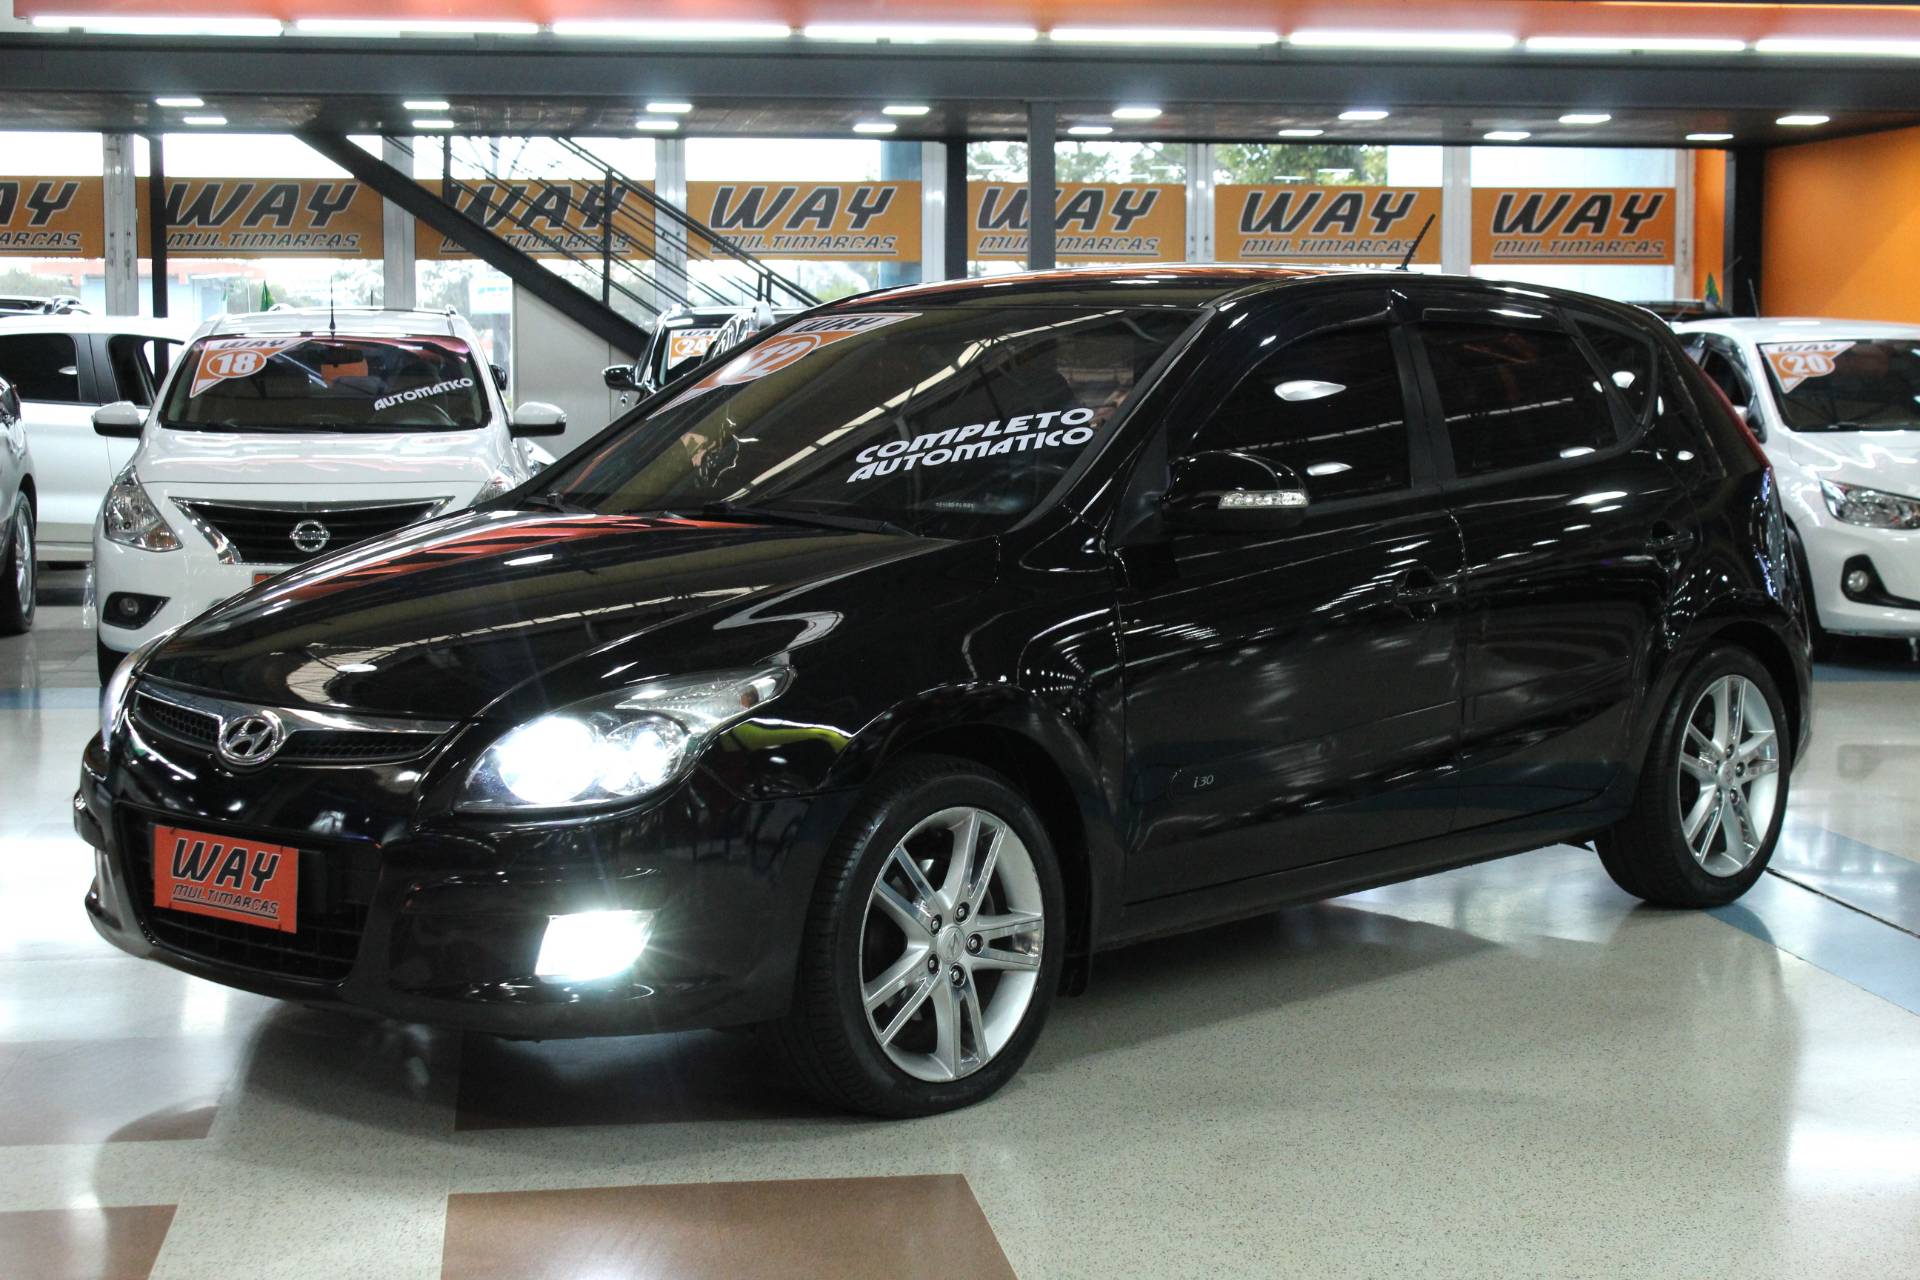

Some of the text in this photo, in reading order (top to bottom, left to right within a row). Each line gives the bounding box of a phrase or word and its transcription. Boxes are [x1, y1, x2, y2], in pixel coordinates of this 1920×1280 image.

[165, 182, 359, 228] WAY
[450, 184, 629, 230] WAY
[709, 186, 897, 230] WAY
[976, 187, 1160, 232] WAY
[1240, 191, 1418, 235] WAY
[1491, 192, 1666, 236] WAY
[167, 232, 360, 249] MULTIMARCAS
[711, 235, 897, 250] MULTIMARCAS
[1494, 240, 1664, 253] MULTIMARCAS
[219, 339, 288, 349] WAY
[799, 316, 886, 333] WAY
[215, 352, 257, 374] 18
[1786, 354, 1829, 375] 20
[374, 377, 474, 411] AUTOMATICO
[855, 407, 1095, 463] COMPLETO
[846, 427, 1094, 483] AUTOMATICO
[171, 837, 281, 893] WAY
[172, 884, 279, 915] MULTIMARCAS
